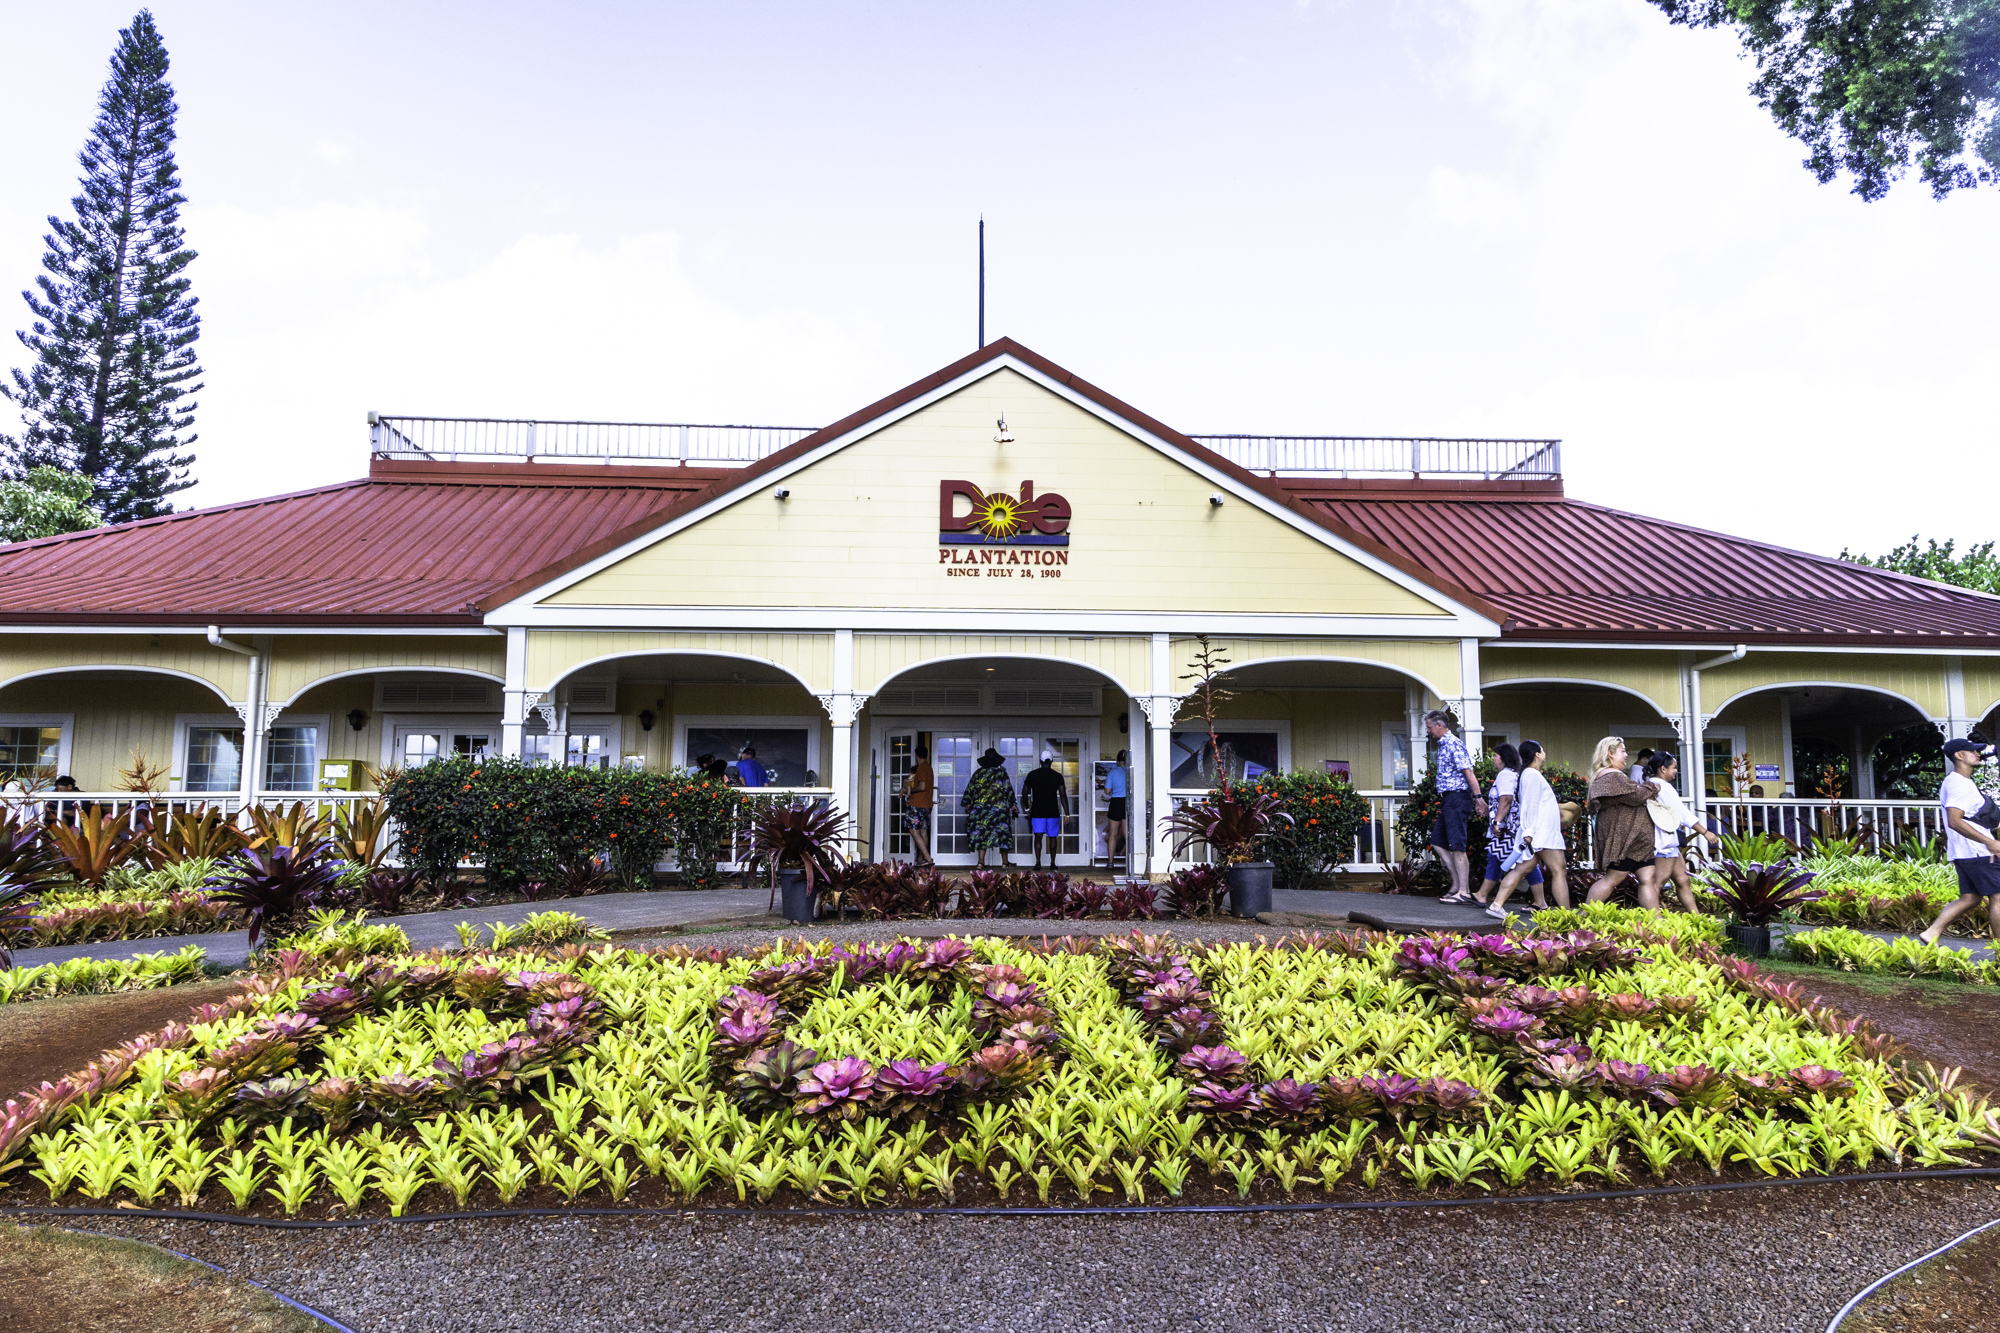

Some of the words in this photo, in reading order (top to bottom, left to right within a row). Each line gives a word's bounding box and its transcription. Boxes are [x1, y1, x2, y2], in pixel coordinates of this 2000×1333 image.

[940, 480, 1072, 538] Dole
[939, 549, 1069, 565] PLANTATION
[947, 568, 980, 577] SINCE
[987, 568, 1014, 577] JULY
[1020, 569, 1034, 579] 28,
[1040, 569, 1061, 578] 1900
